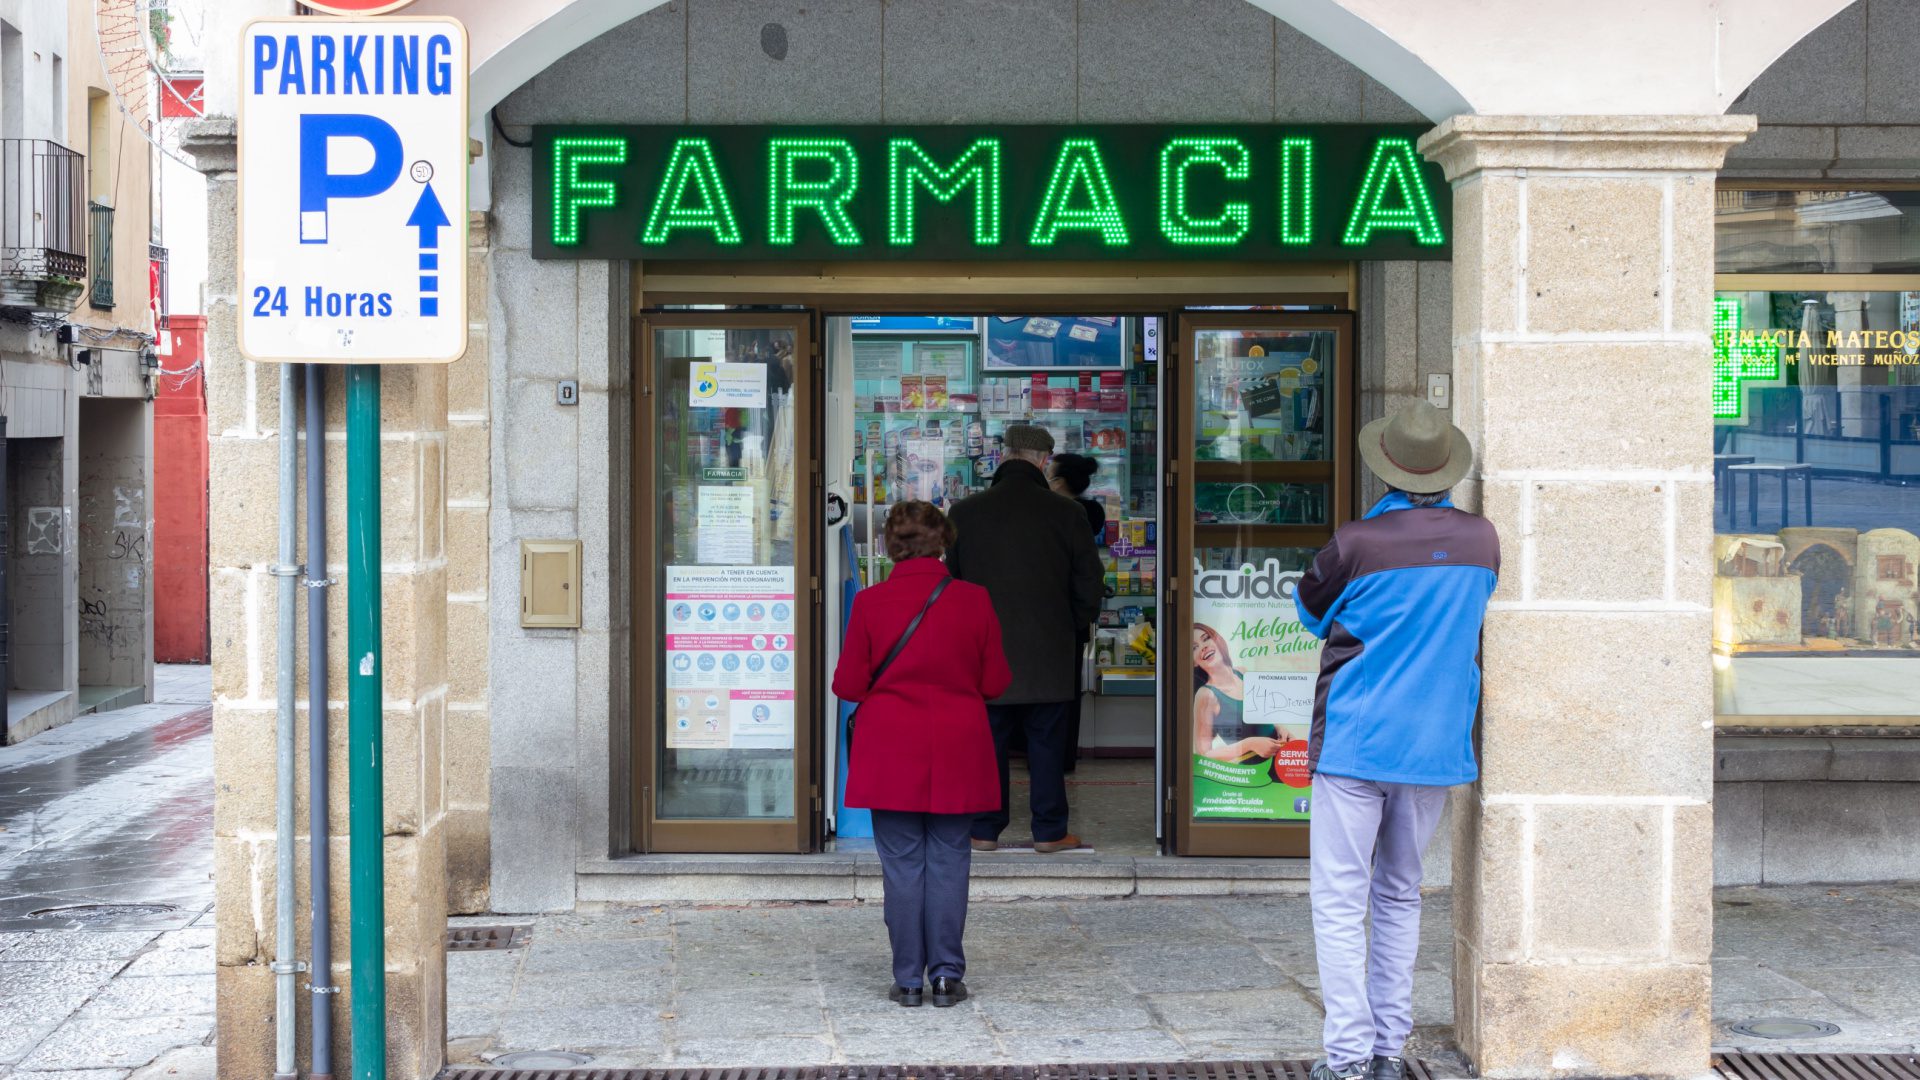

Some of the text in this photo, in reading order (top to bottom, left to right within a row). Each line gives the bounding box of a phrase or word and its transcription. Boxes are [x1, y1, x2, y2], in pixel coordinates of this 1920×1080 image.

[254, 35, 452, 96] PARKING
[300, 114, 404, 244] P
[553, 137, 1446, 245] FARMACIA
[252, 286, 393, 317] 24 Horas
[1713, 329, 1920, 349] ARMACIA MATEOS
[1809, 354, 1866, 366] VICENTE
[1873, 350, 1920, 366] MUÑOZ
[693, 364, 719, 398] 5
[691, 575, 729, 583] PREVENCIÓN
[1211, 600, 1266, 608] Asesoramiento
[1239, 635, 1319, 659] con salud
[1280, 750, 1309, 758] SERVIC
[1198, 758, 1257, 775] ASESORAMIENTO
[1203, 769, 1251, 784] NUTRICIONAL
